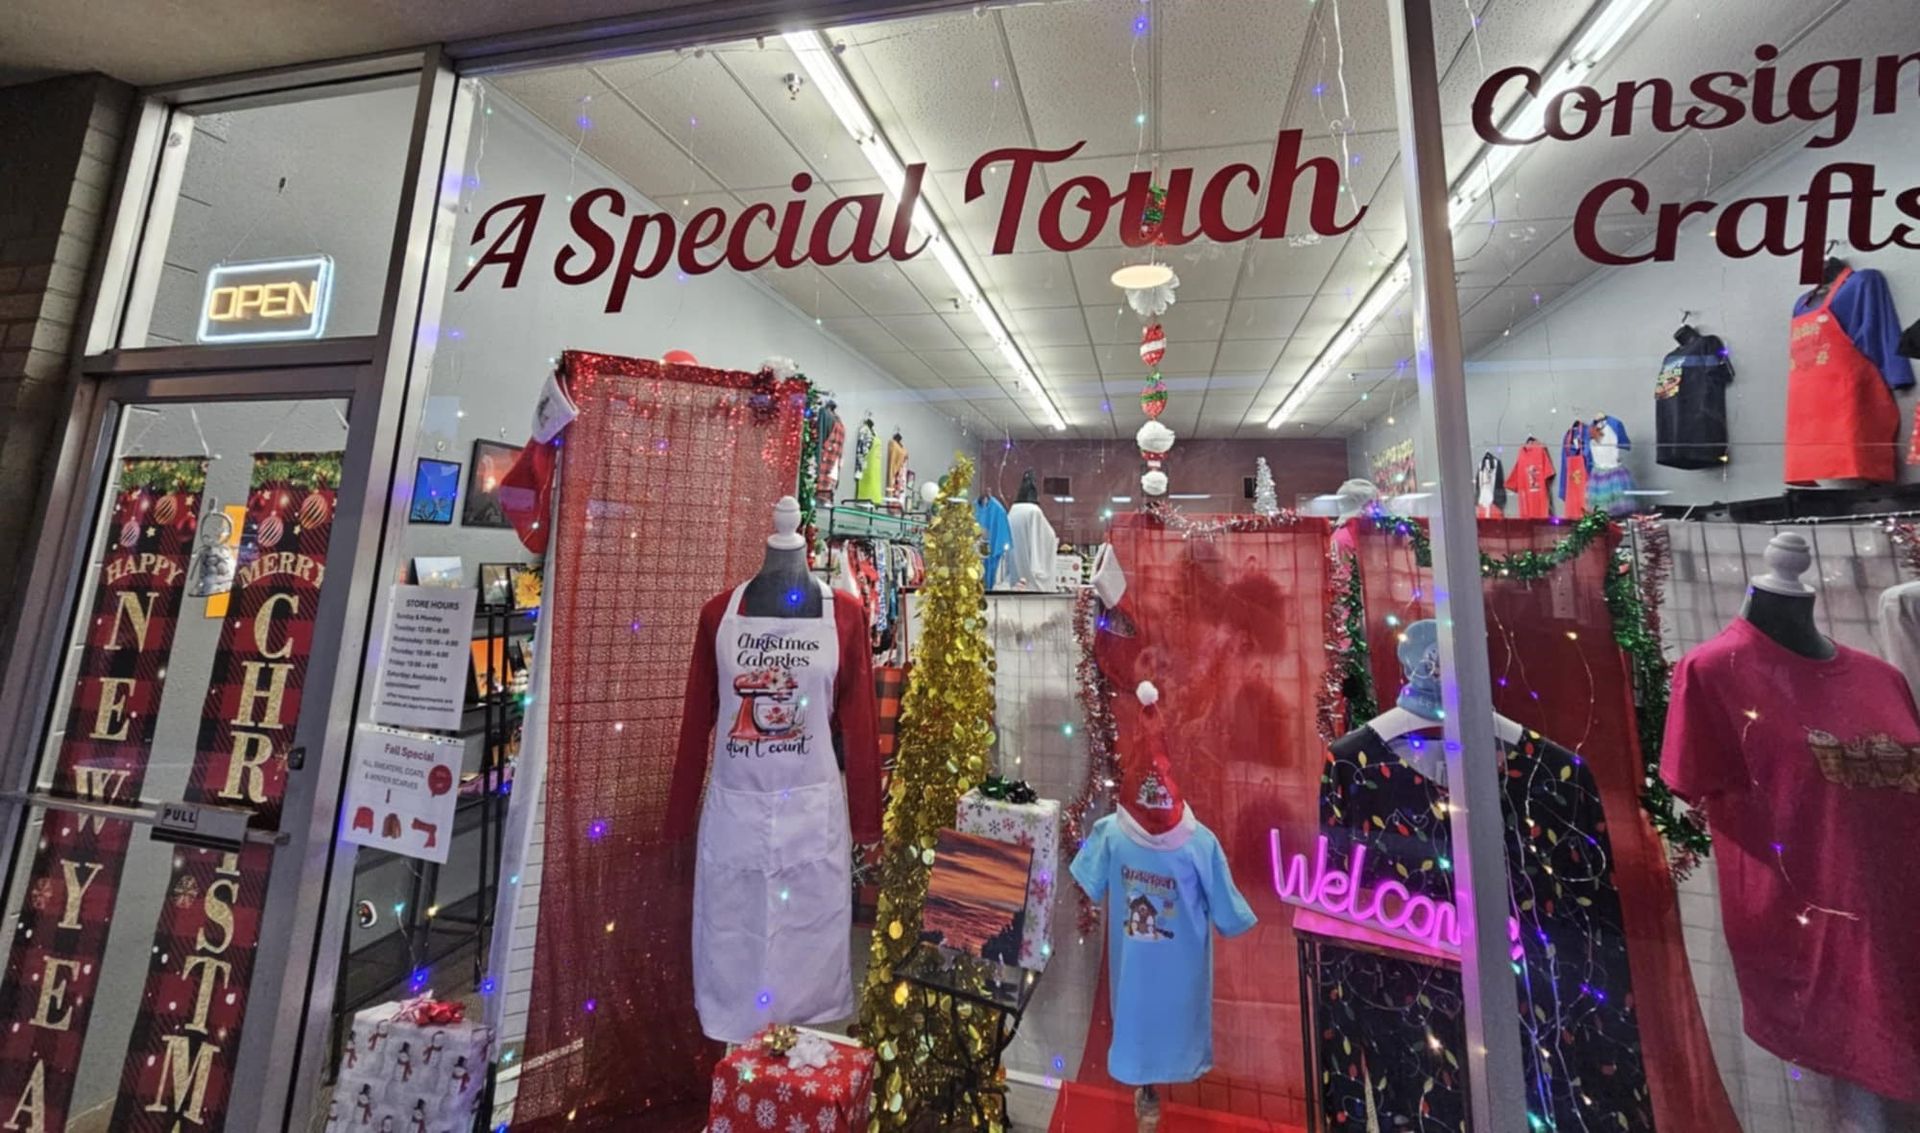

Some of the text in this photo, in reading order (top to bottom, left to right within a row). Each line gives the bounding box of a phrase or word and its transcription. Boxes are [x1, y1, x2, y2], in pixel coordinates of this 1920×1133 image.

[454, 129, 1368, 313] A Special Touch
[208, 281, 318, 320] OPEN
[106, 552, 184, 586] HAPPY
[406, 599, 459, 610] STORE HOURS
[737, 632, 820, 652] Christmas
[737, 650, 810, 669] Calories
[384, 743, 435, 762] Fall Special
[768, 735, 814, 757] count
[164, 807, 196, 823] PULL
